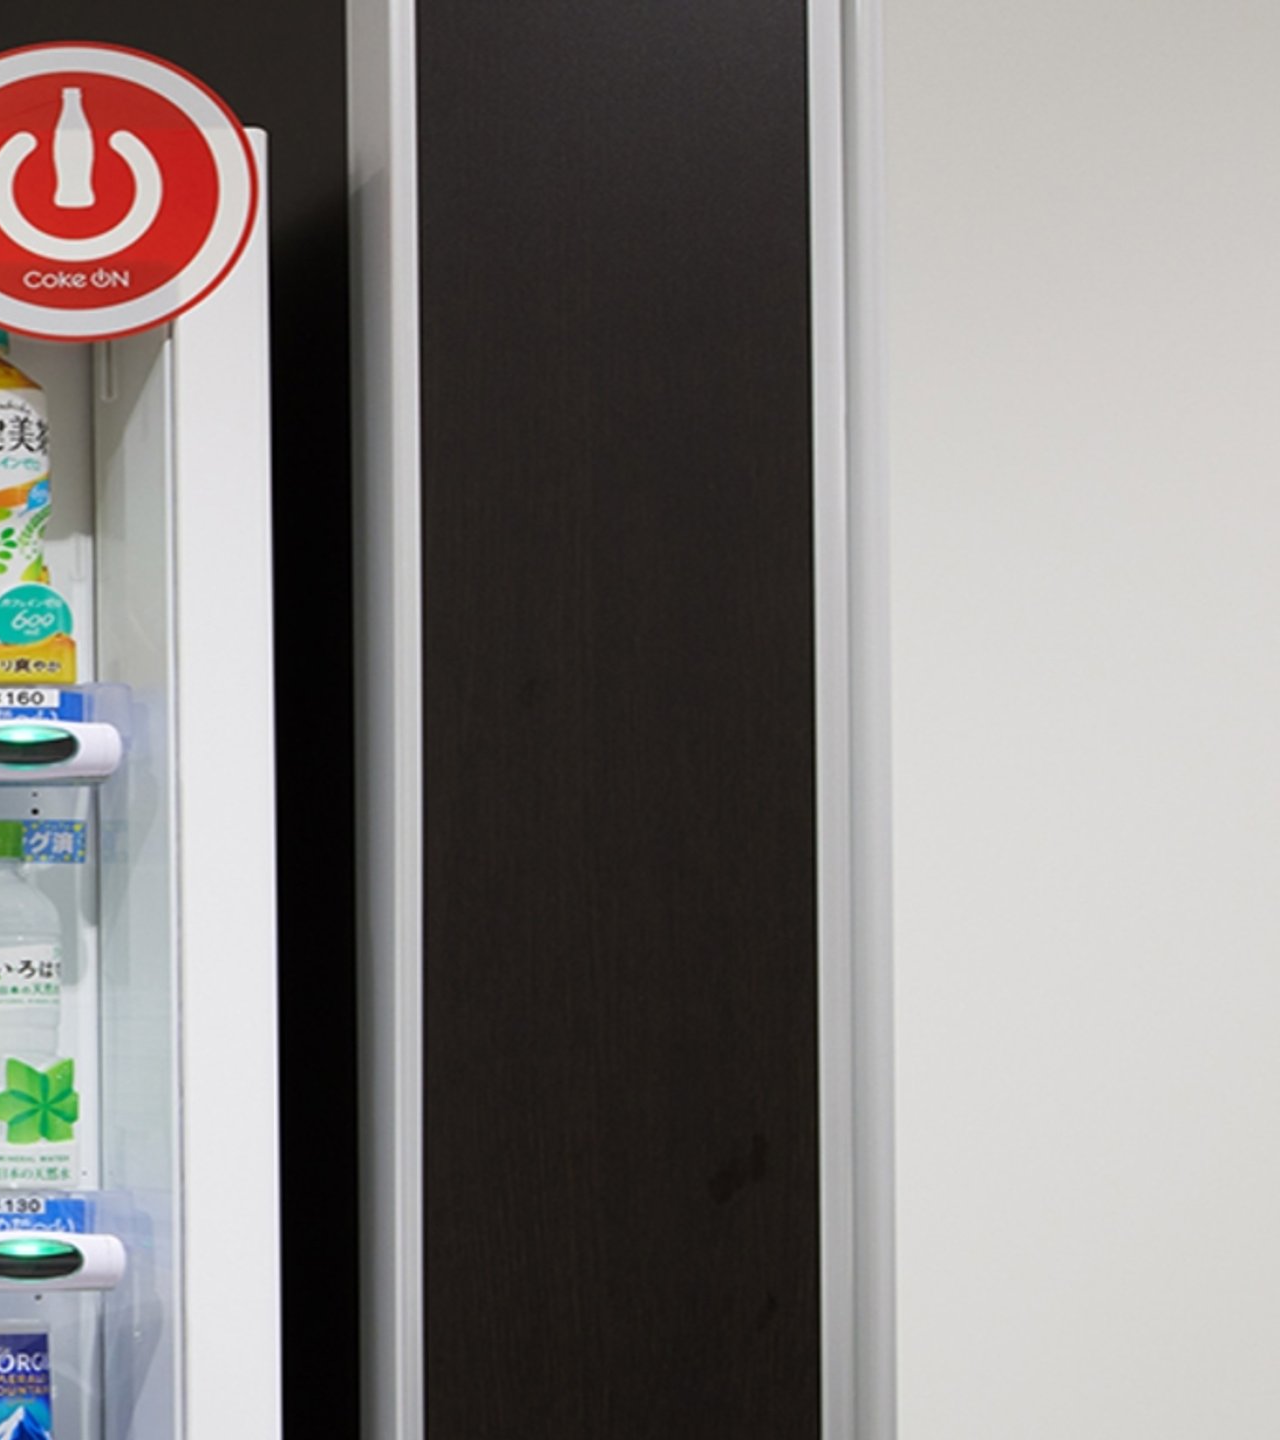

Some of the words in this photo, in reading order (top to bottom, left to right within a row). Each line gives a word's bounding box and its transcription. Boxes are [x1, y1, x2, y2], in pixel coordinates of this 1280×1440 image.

[23, 270, 86, 290] Coke
[89, 267, 130, 289] ON
[11, 613, 56, 630] 600
